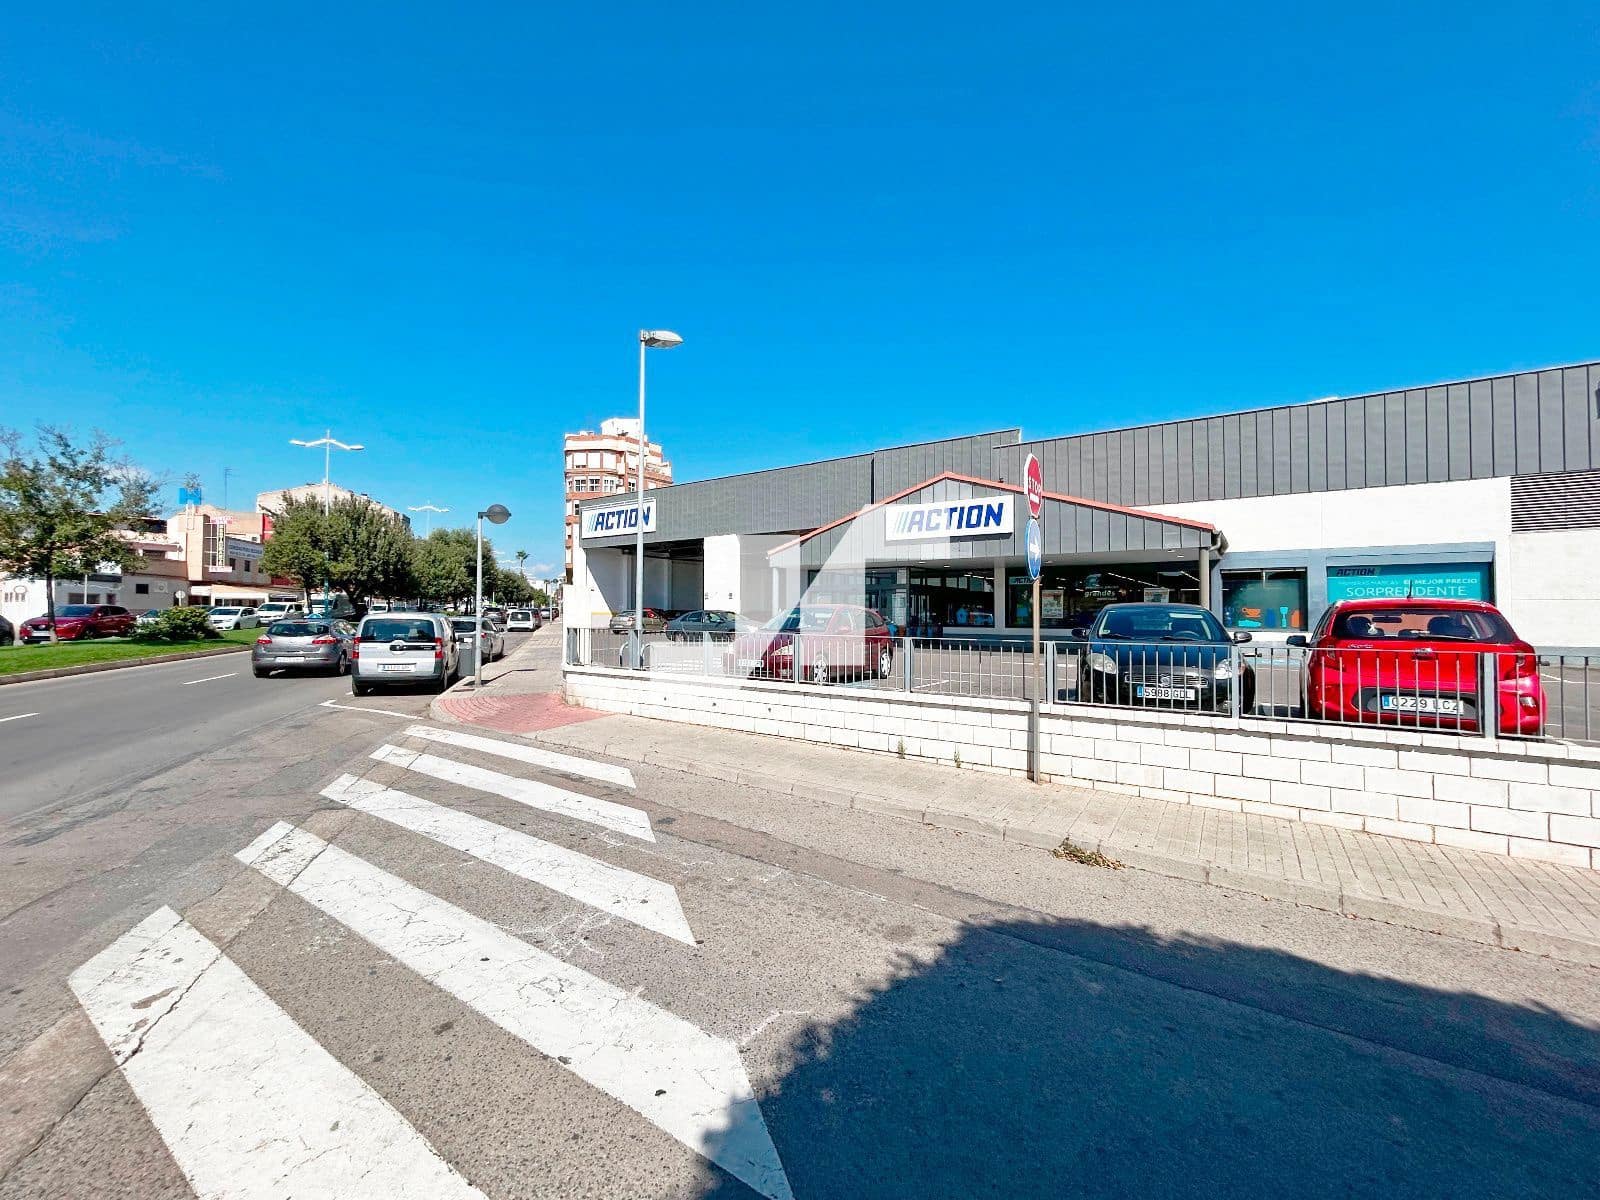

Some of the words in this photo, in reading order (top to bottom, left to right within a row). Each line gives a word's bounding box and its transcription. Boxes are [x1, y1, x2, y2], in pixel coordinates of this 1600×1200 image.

[1028, 475, 1041, 495] STOP
[594, 506, 651, 531] ACTION
[908, 502, 1004, 533] ACTION
[1336, 568, 1376, 577] ACTION
[1346, 585, 1467, 597] SORPRENDENTE
[1391, 697, 1428, 709] 0229
